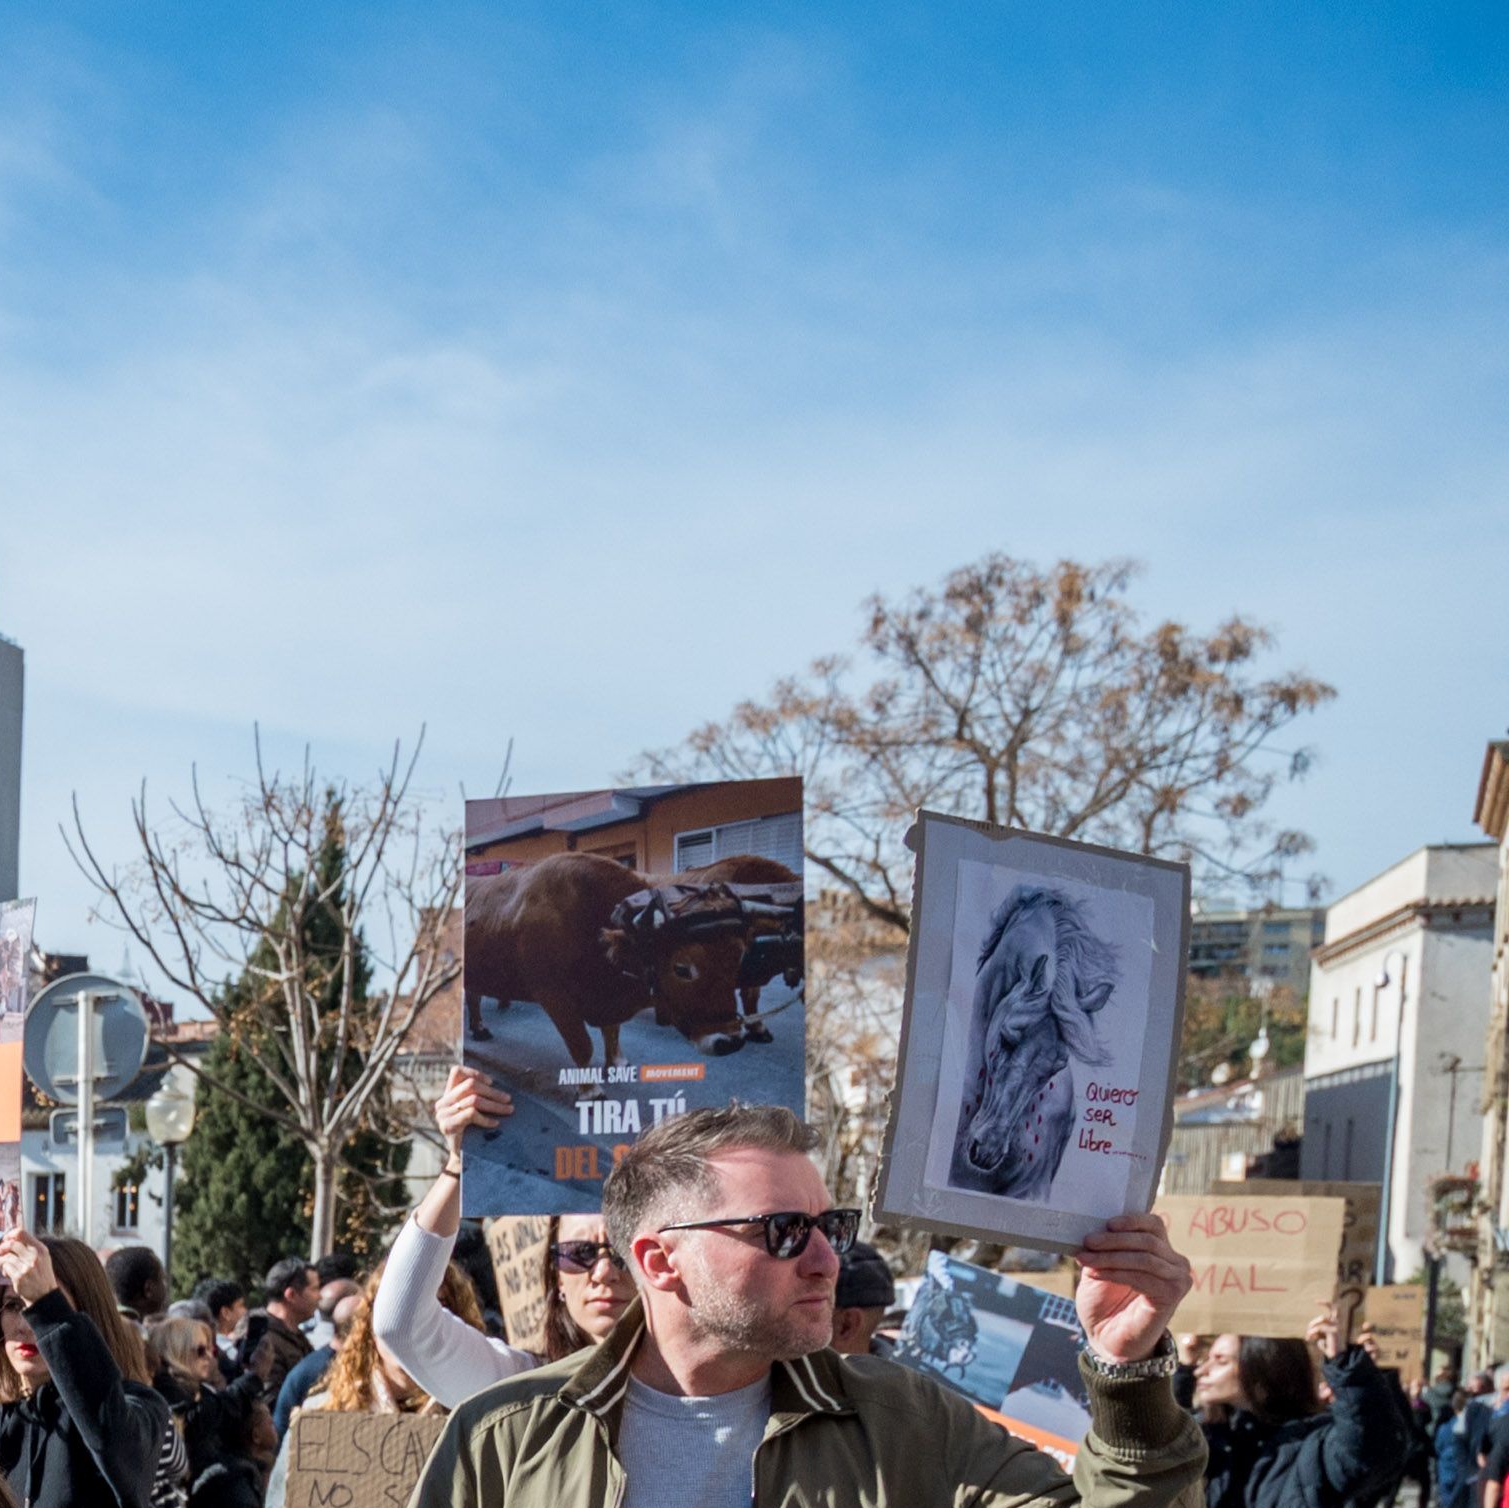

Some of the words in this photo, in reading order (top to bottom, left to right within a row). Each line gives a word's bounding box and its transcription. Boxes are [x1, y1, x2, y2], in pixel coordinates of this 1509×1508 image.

[558, 1068, 605, 1086] ANIMAL
[608, 1065, 637, 1083] SAVE
[575, 1099, 642, 1135] TIRA
[555, 1147, 603, 1180] DEL
[1188, 1205, 1308, 1239] ABUSO
[1191, 1264, 1288, 1296] MAL
[297, 1415, 373, 1475] ELS
